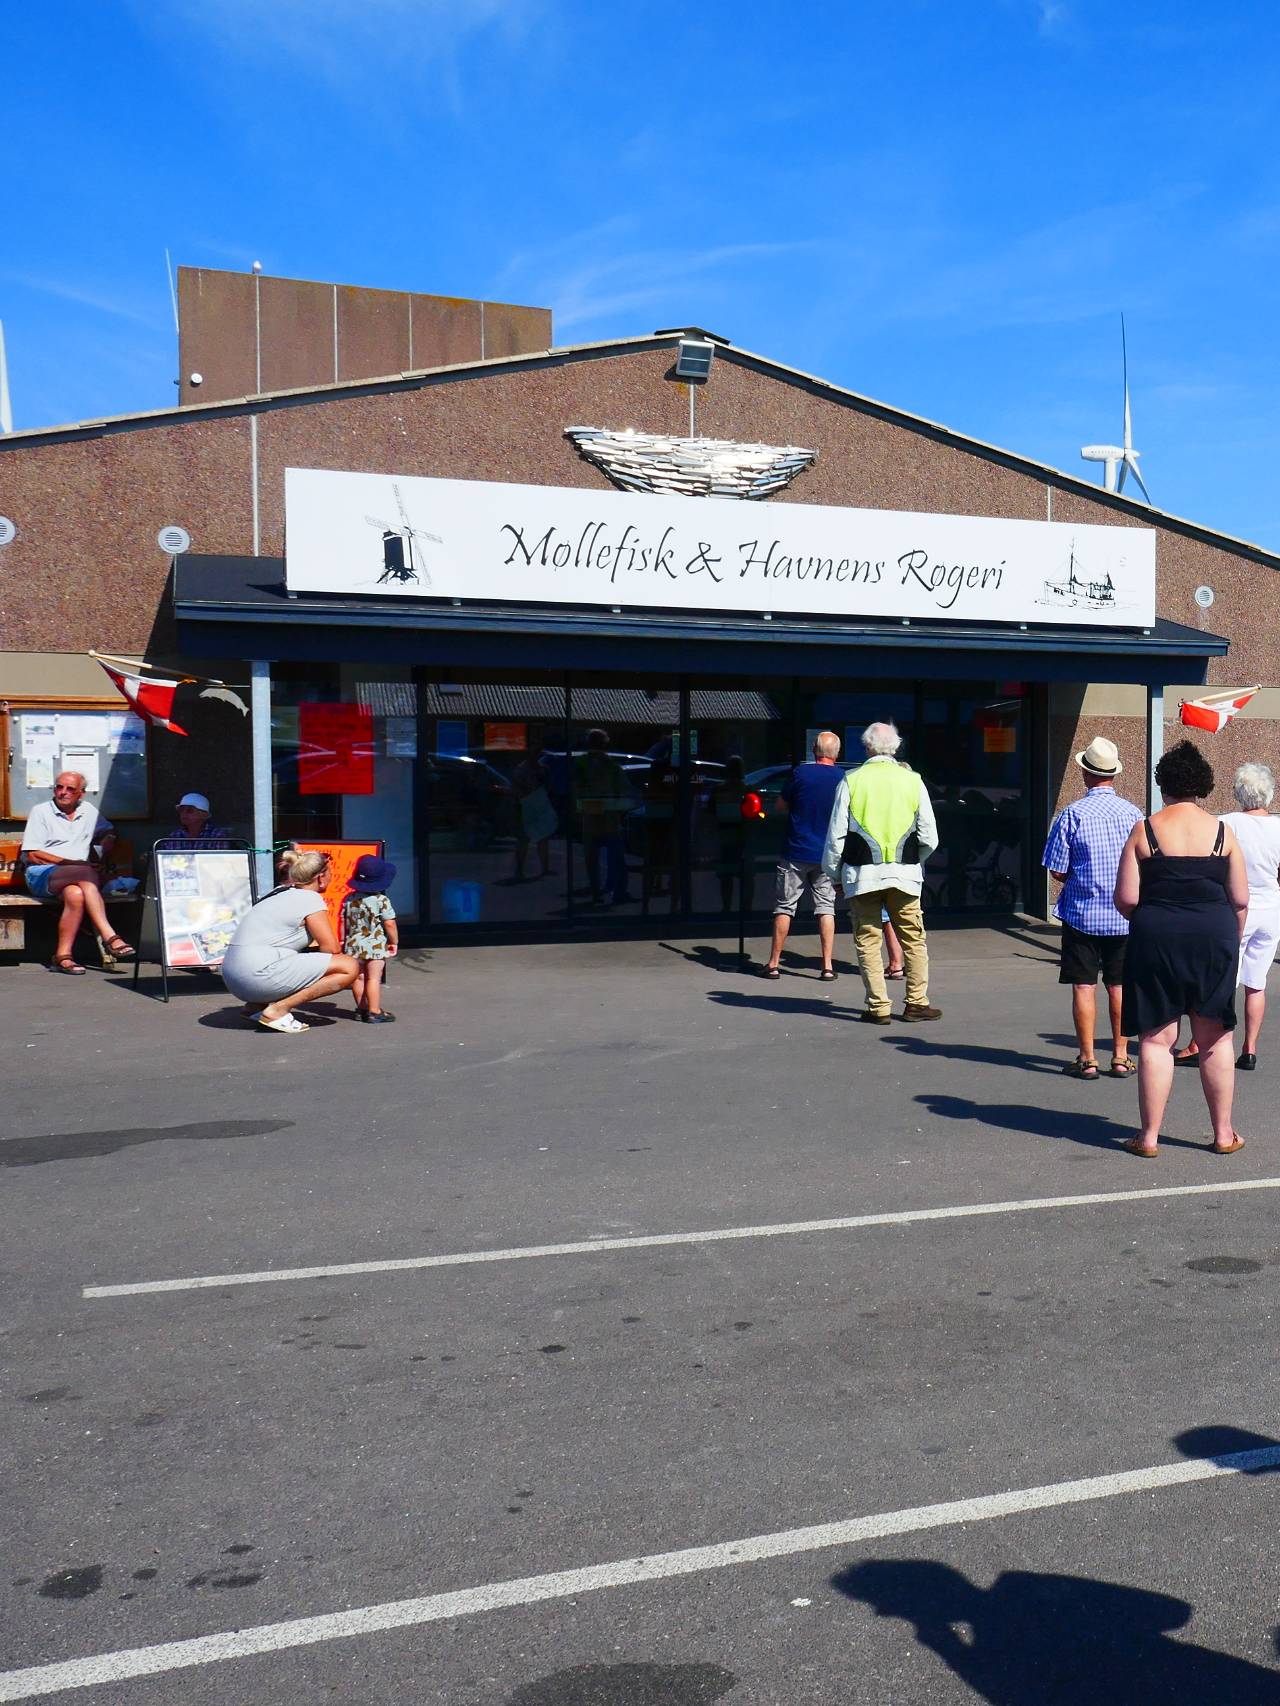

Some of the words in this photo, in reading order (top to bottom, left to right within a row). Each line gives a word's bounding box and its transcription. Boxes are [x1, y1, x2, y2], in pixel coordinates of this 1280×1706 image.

[500, 521, 678, 584] Møllefisk
[685, 541, 724, 583] &
[738, 540, 885, 584] Havnens
[898, 549, 1006, 609] Røgeri
